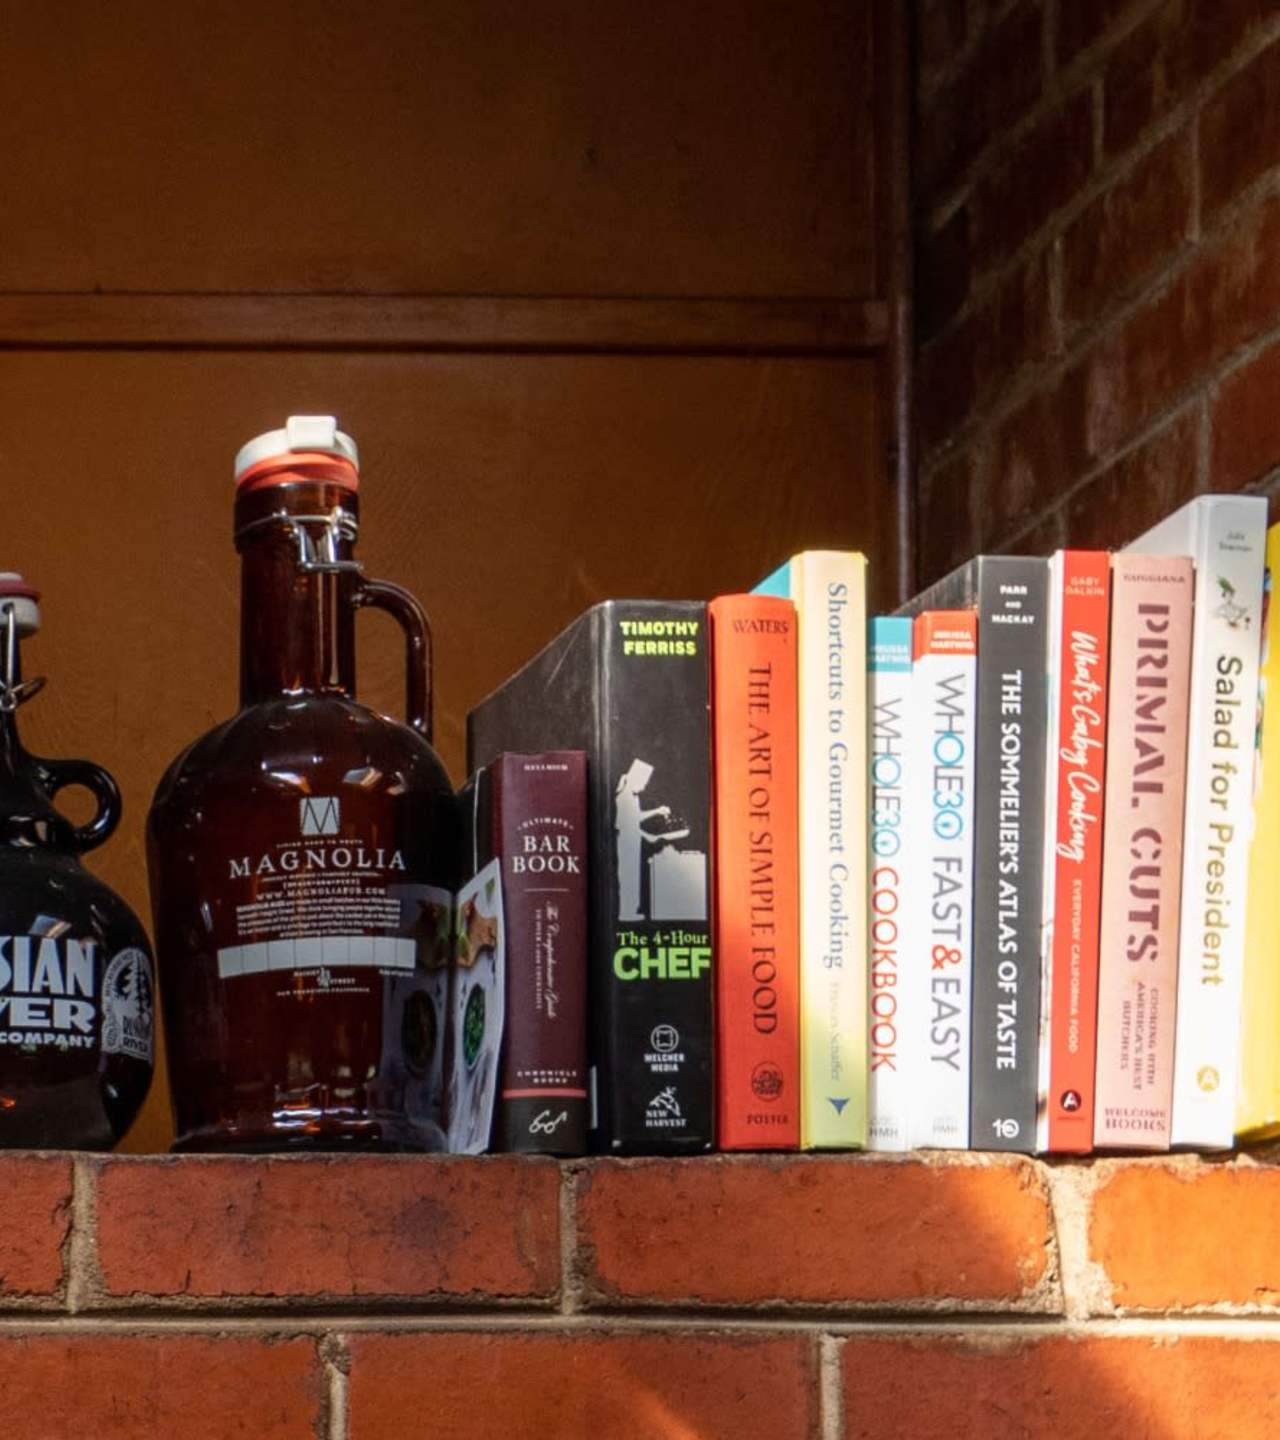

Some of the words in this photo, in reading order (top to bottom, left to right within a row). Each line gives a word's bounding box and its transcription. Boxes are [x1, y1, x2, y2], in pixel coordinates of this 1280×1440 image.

[620, 621, 698, 636] TIMOTHY
[623, 641, 696, 656] FERRISS
[732, 620, 789, 635] WATERS
[828, 582, 847, 701] Shortcuts
[991, 614, 1035, 624] MACKAY
[748, 663, 772, 714] THE
[1001, 669, 1022, 714] THE
[1131, 603, 1170, 808] PRIMAL
[1213, 655, 1243, 749] Salad
[828, 709, 844, 733] to
[1058, 703, 1103, 770] Gaby
[748, 724, 772, 781] ART
[871, 698, 902, 857] WHOLE30
[934, 674, 966, 840] WHOLE30
[748, 787, 771, 822] OF
[829, 742, 848, 853] Gourmet
[998, 722, 1022, 874] SOMMELIER'S
[1210, 761, 1238, 811] for
[524, 835, 571, 853] BAR
[1055, 770, 1101, 864] Cooking
[229, 847, 406, 879] MAGNOLIA
[512, 855, 581, 873] BOOK
[749, 831, 775, 937] SIMPLE
[822, 864, 849, 969] Cooking
[931, 857, 963, 941] FAST
[997, 880, 1019, 954] ATLAS
[1125, 827, 1163, 963] CUTS
[1202, 822, 1234, 985] President
[614, 947, 712, 980] CHEF
[616, 931, 648, 946] The
[653, 930, 708, 946] 4-Hour
[931, 944, 962, 970] &
[751, 946, 778, 1035] FOOD
[871, 867, 899, 1072] COOKBOOK
[997, 961, 1018, 994] OF
[1069, 943, 1081, 1017] CALIFORNIA
[930, 978, 961, 1071] EASY
[996, 1000, 1017, 1070] TASTE
[1068, 1018, 1078, 1054] FOOD
[1120, 1000, 1132, 1071] BUTCHERS
[1134, 981, 1146, 1055] AMERICA'S
[1147, 988, 1159, 1049] COOKING
[1133, 1057, 1144, 1091] BEST
[646, 1110, 668, 1118] NEW
[646, 1119, 687, 1128] HARVEST
[1105, 1119, 1166, 1131] BOOKS
